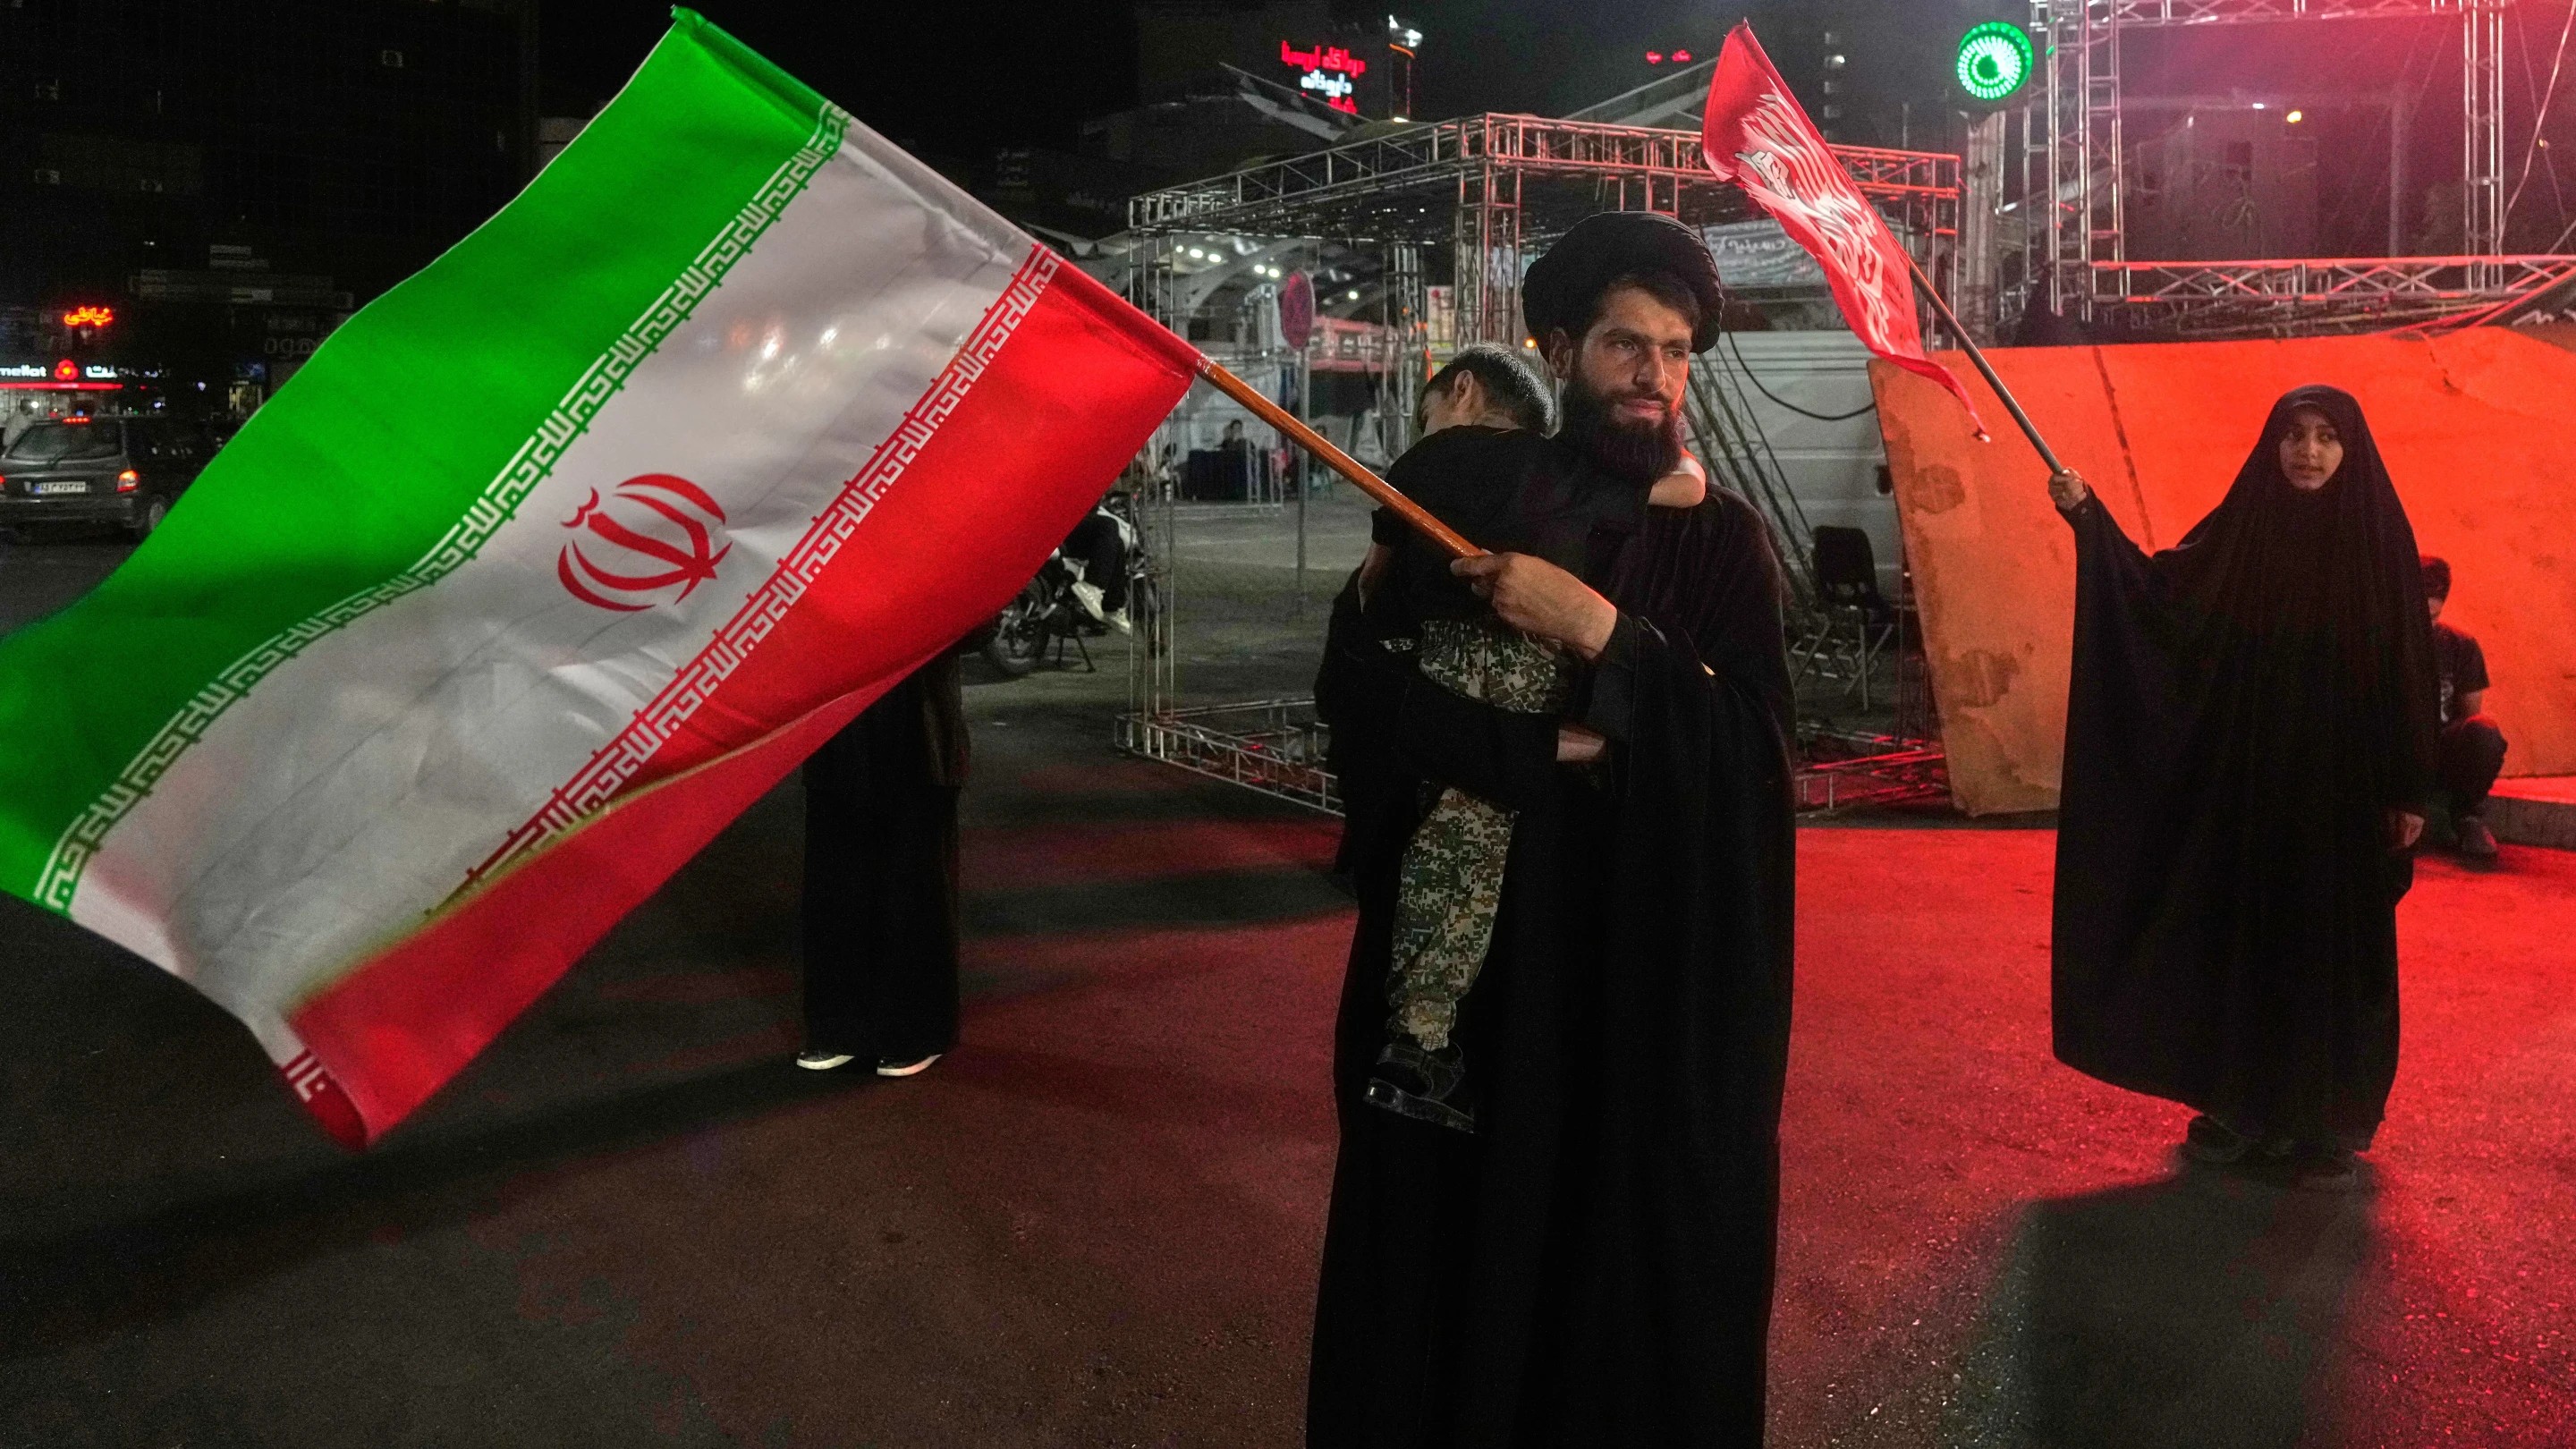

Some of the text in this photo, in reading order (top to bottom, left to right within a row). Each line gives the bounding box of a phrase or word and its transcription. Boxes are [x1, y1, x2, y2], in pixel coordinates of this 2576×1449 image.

[1301, 69, 1352, 97] داروخانه
[64, 306, 114, 326] خیاطی
[0, 364, 47, 377] mellat
